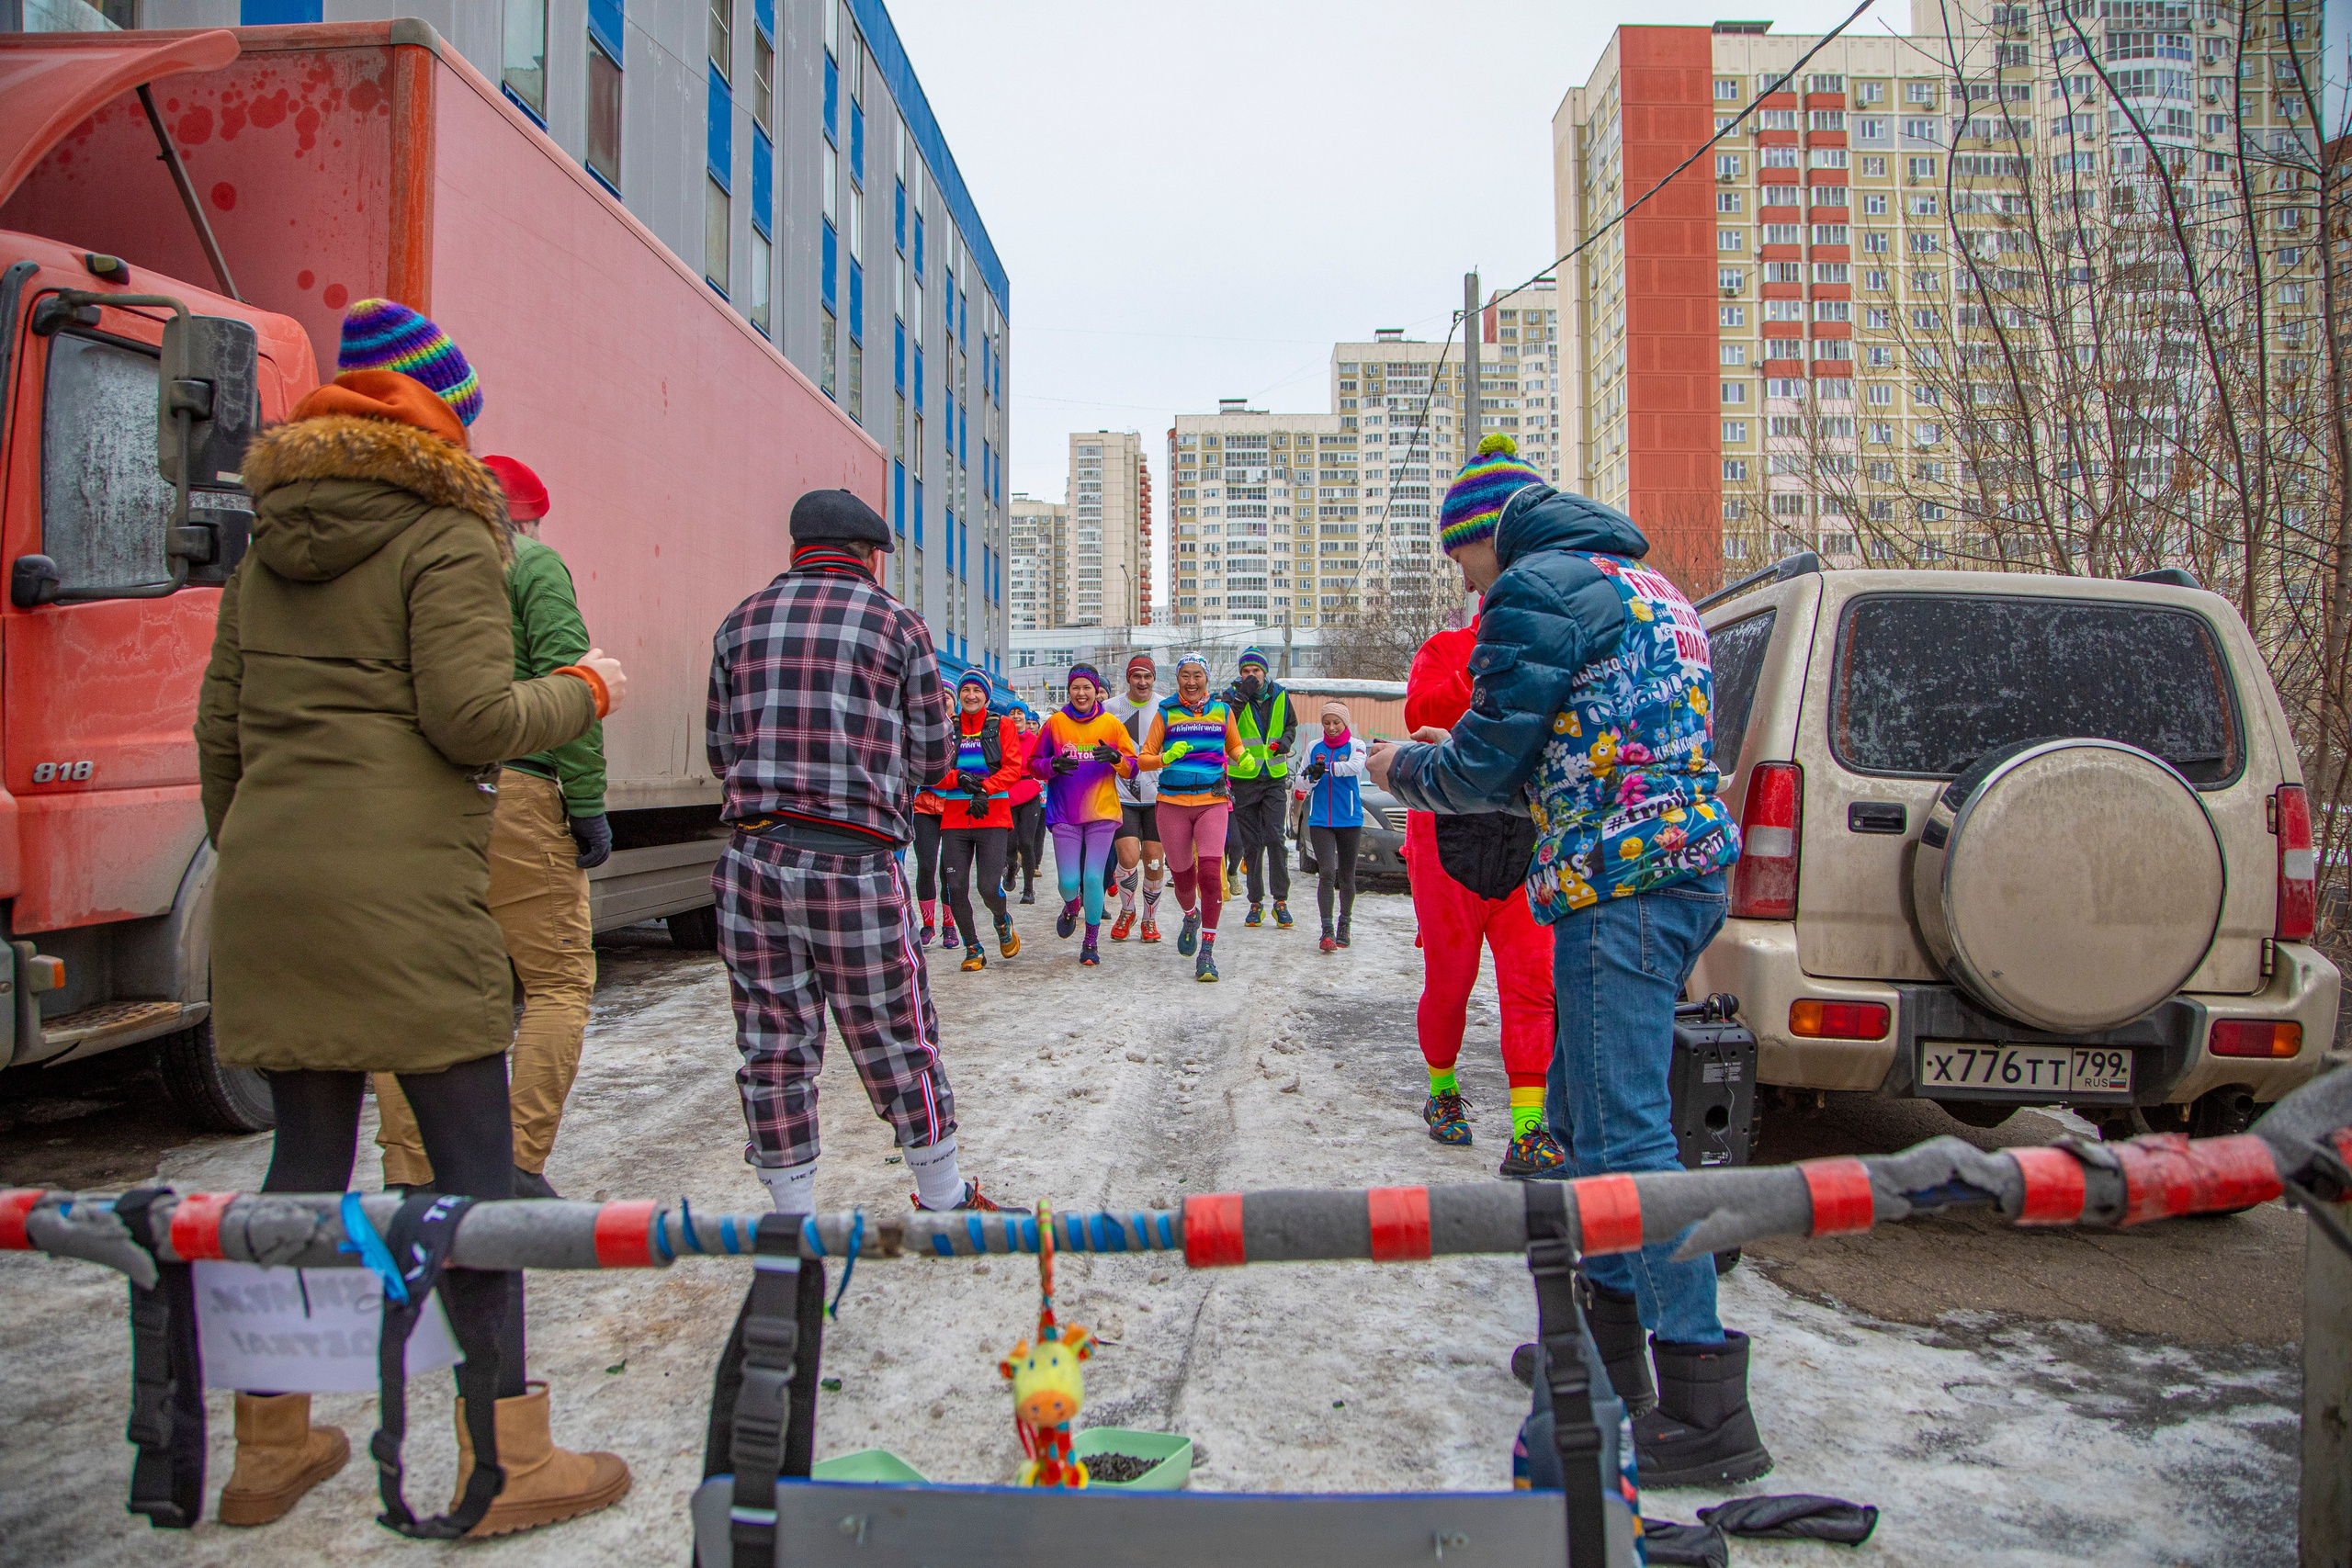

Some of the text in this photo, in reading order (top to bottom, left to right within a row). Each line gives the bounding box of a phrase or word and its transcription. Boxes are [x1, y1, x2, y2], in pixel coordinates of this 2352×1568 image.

[32, 761, 94, 784] 818
[2075, 1051, 2123, 1077] 799
[2085, 1077, 2109, 1088] RUS
